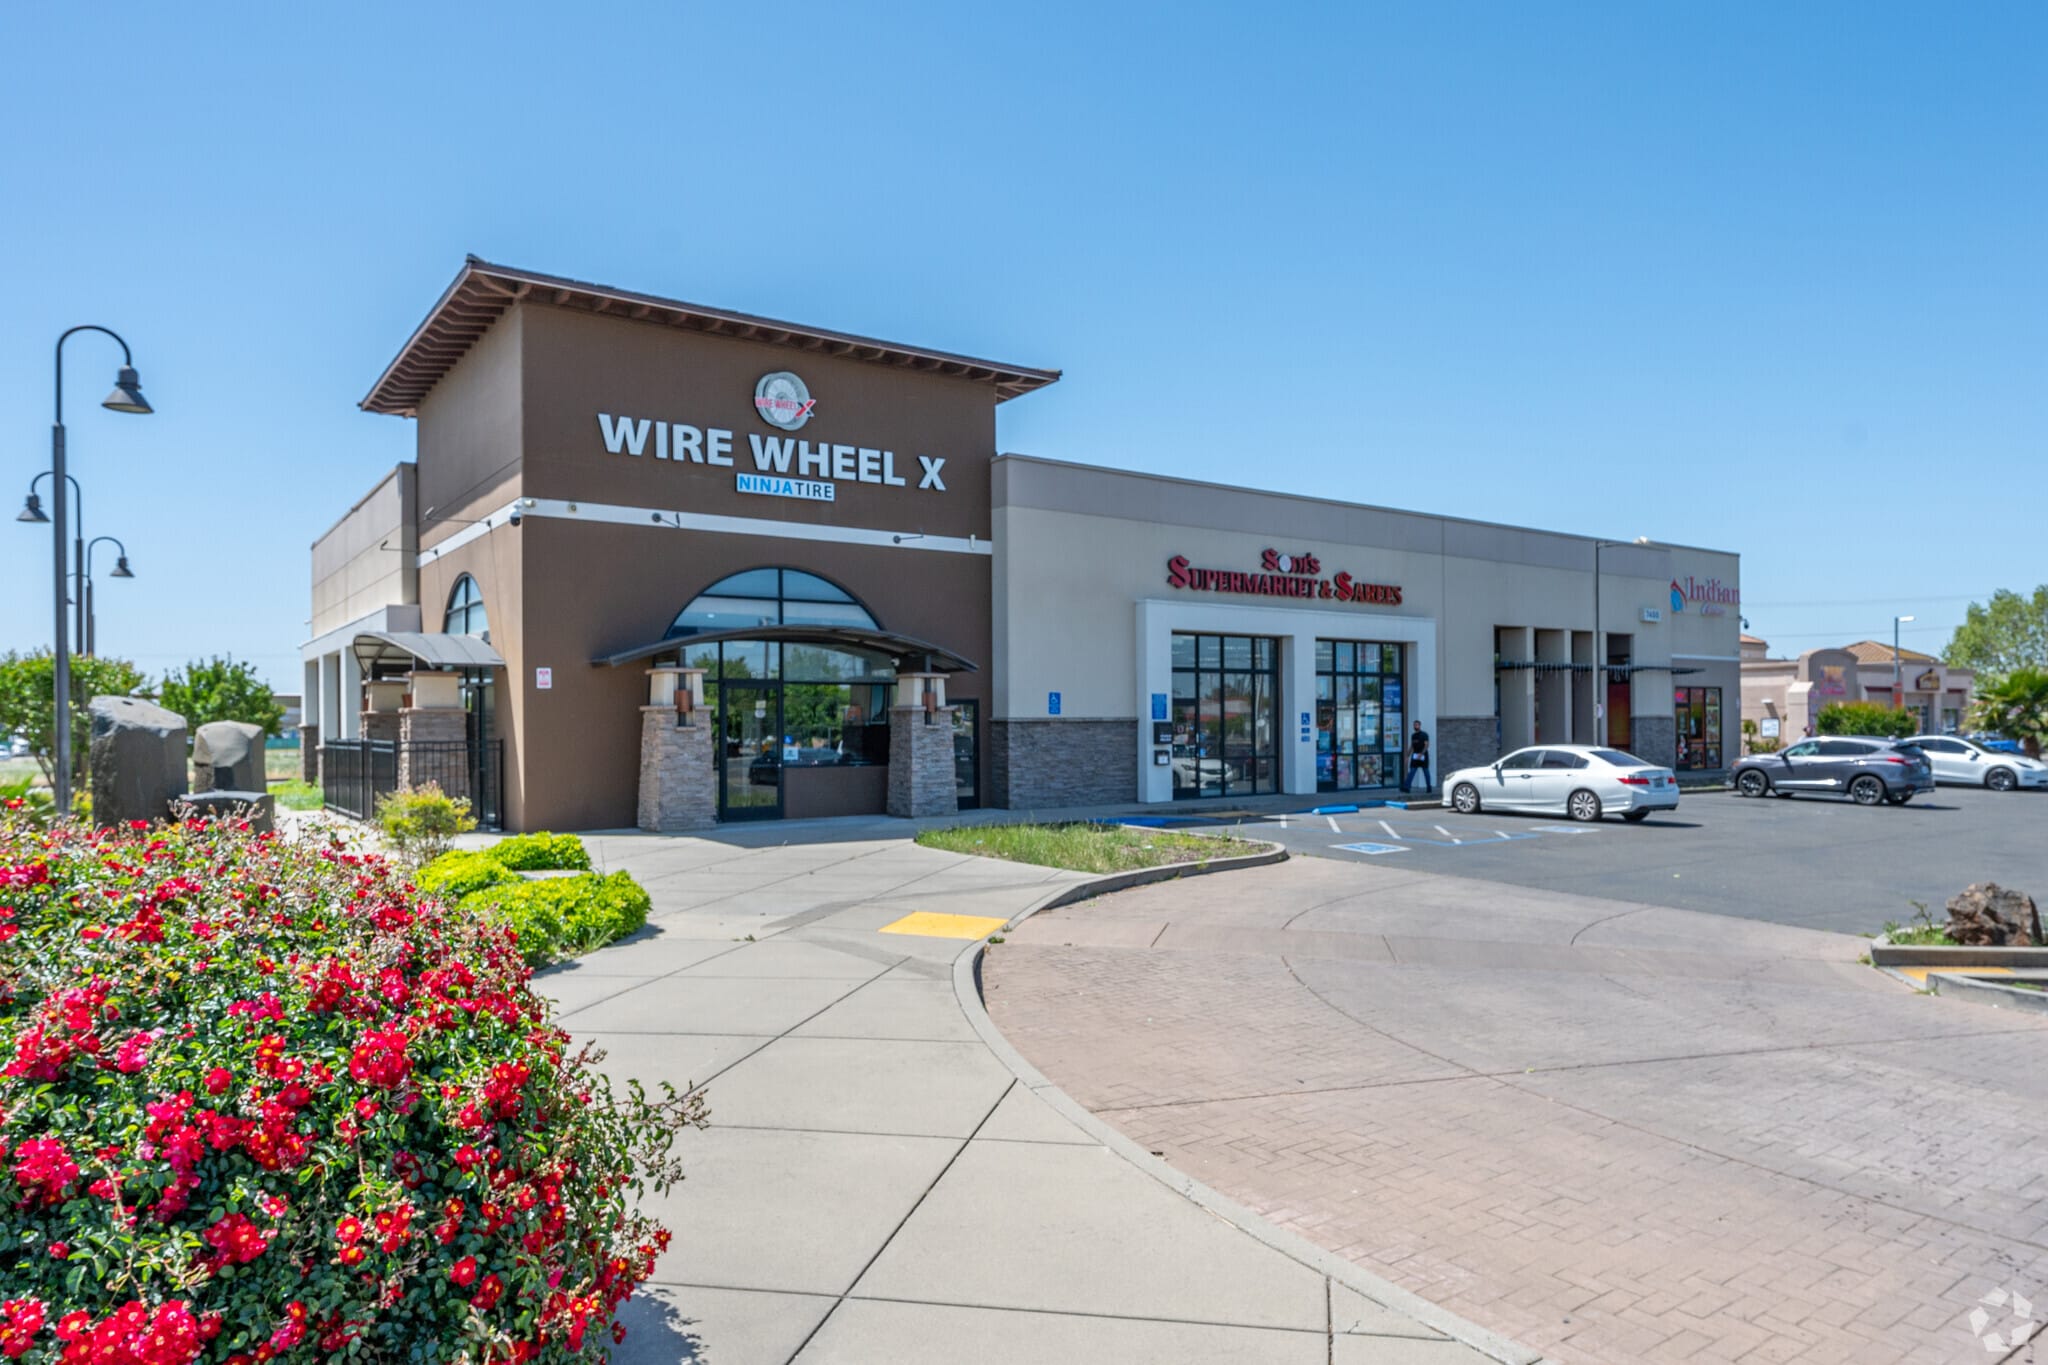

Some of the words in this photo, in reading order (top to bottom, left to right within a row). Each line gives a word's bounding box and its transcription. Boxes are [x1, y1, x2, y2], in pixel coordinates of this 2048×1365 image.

[597, 412, 734, 468] WIRE
[748, 433, 906, 487] WHEEL
[917, 455, 947, 492] X
[1166, 554, 1318, 599] SUPERMARKET
[1318, 579, 1334, 600] &
[1333, 570, 1403, 606] SAREES
[1686, 575, 1740, 605] Indian
